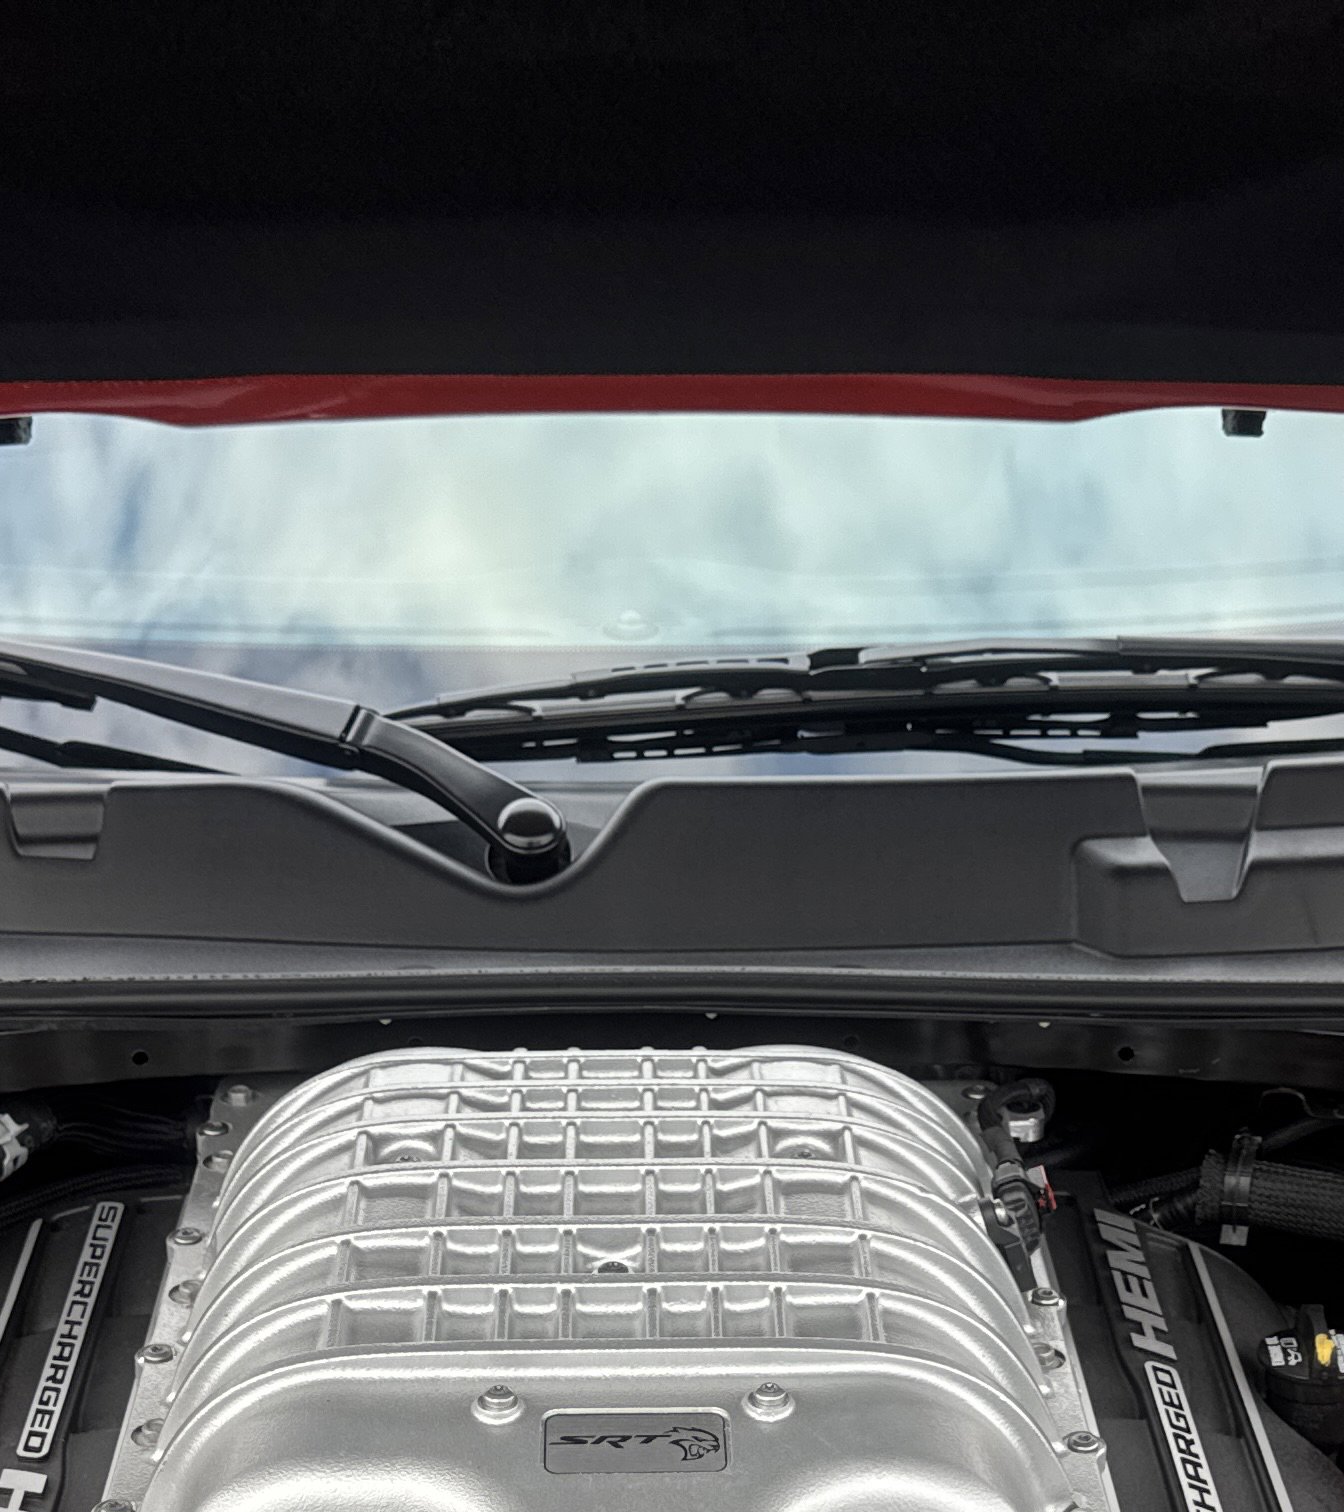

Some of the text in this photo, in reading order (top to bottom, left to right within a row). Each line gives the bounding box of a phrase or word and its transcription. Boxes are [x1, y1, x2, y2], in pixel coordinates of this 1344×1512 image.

[22, 1203, 118, 1454] SUPERCHARGED
[1093, 1207, 1178, 1361] HEMI
[549, 1434, 673, 1449] SRT
